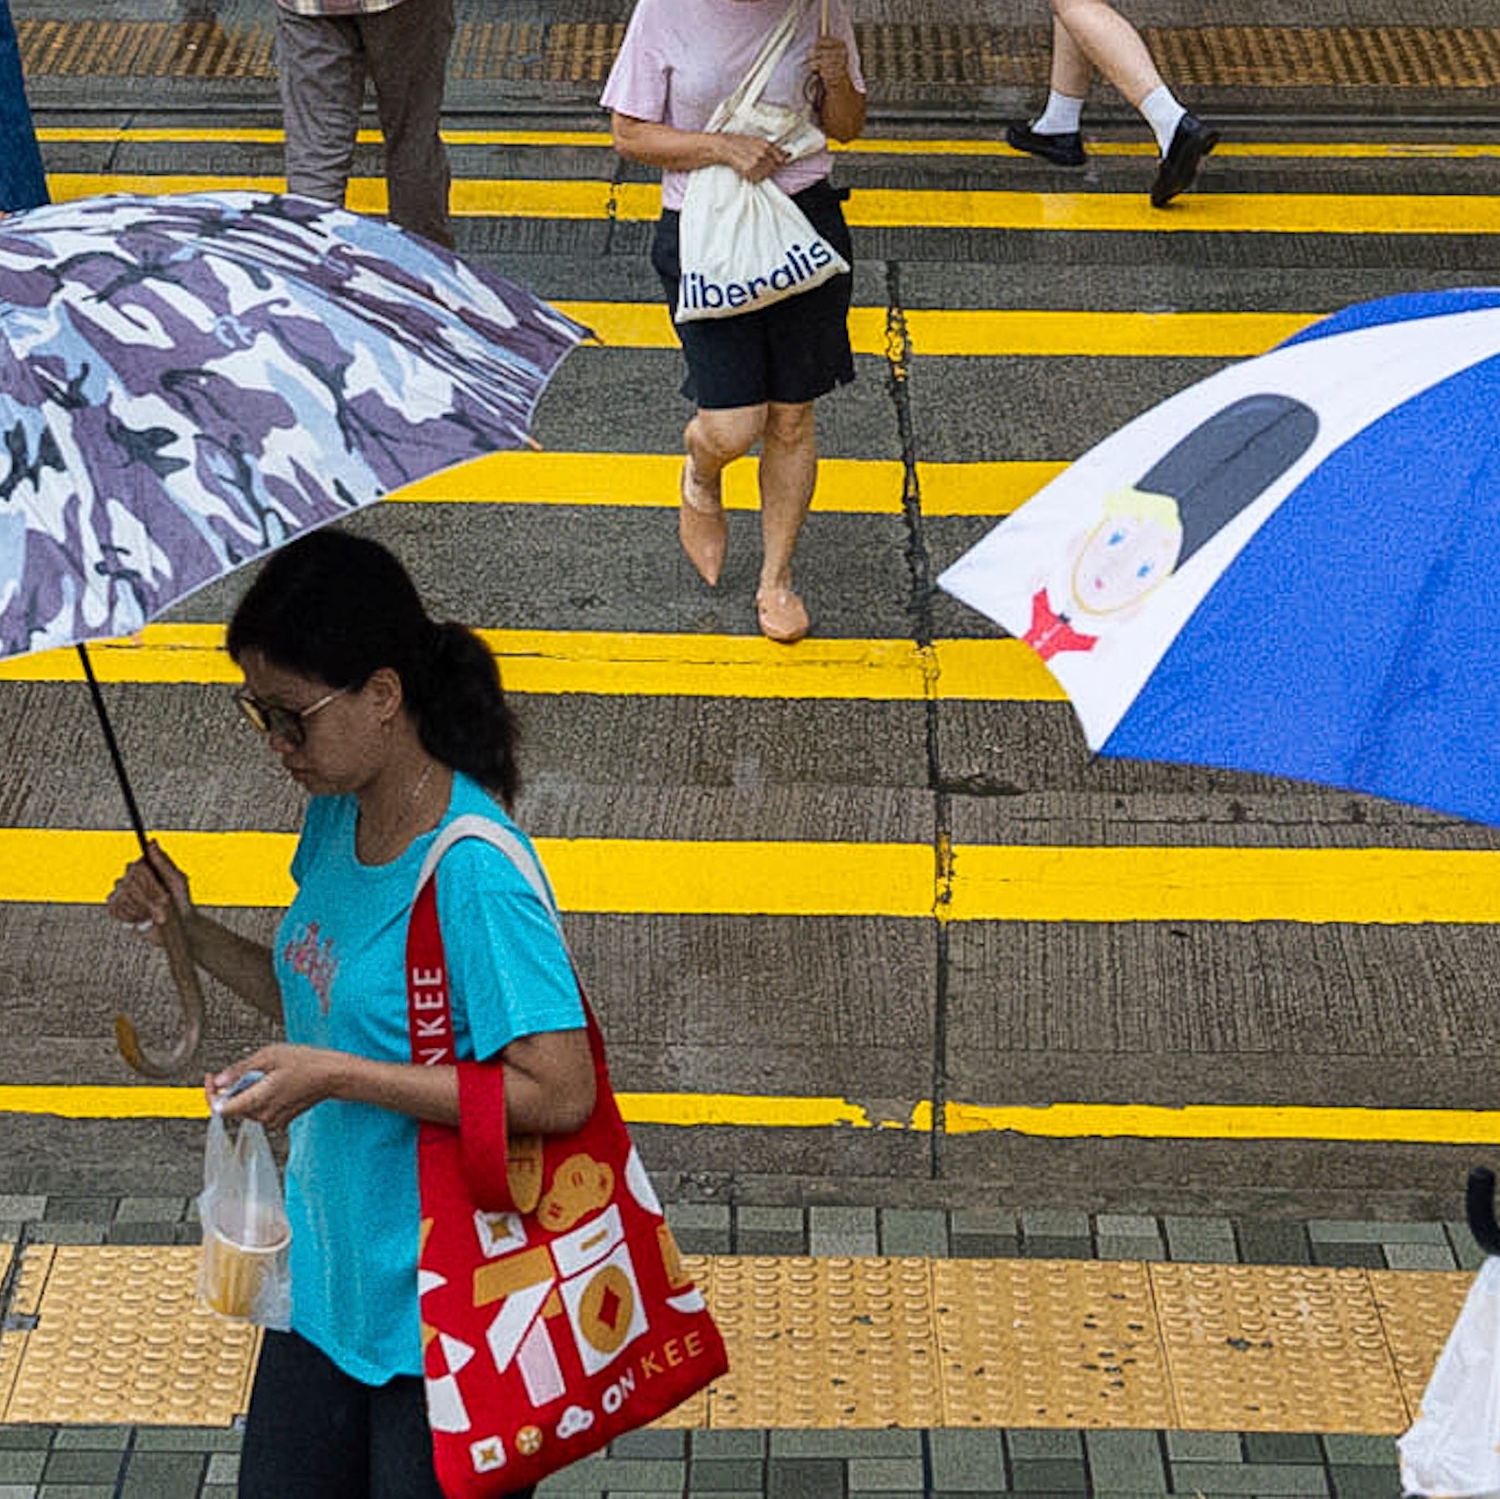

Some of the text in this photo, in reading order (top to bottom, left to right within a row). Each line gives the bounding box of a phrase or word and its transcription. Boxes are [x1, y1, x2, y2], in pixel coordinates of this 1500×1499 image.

[682, 240, 833, 311] liberalis
[412, 966, 447, 1038] KEE
[601, 1330, 705, 1415] ON KEE
